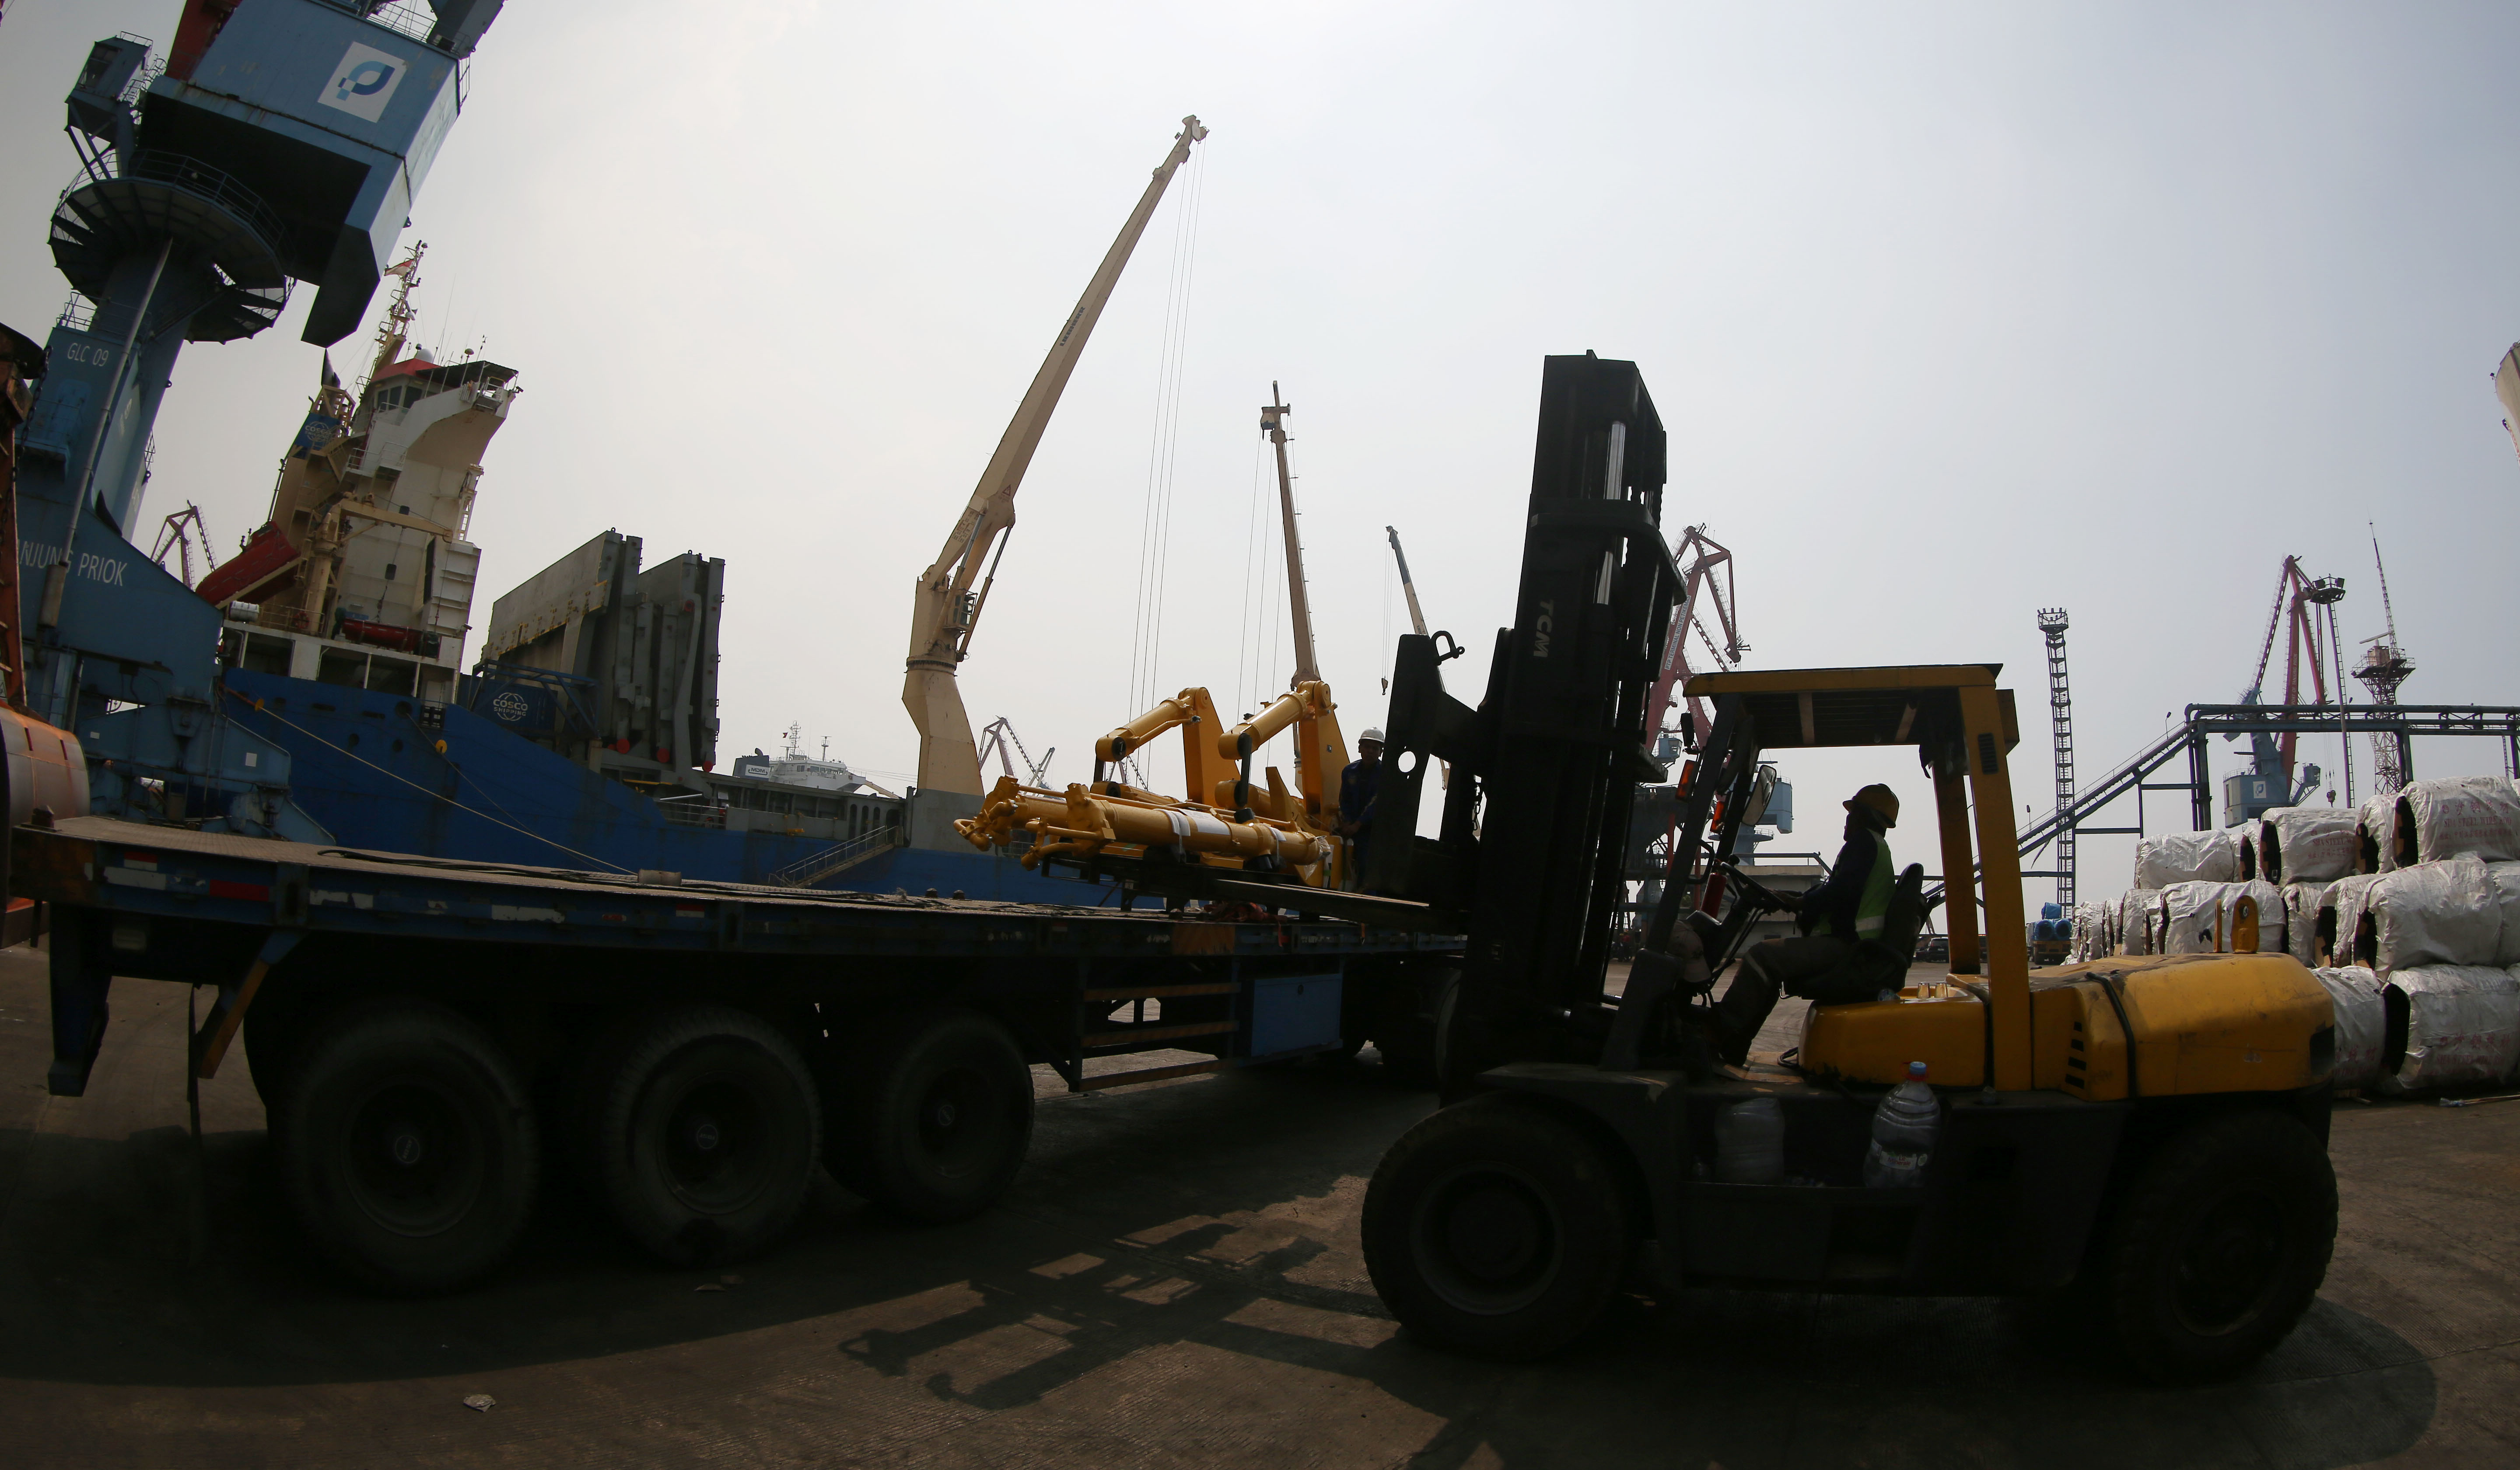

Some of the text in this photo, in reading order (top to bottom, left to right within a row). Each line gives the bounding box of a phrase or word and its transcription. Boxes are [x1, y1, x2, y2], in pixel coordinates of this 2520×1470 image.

[67, 343, 109, 367] GLC 09
[18, 539, 127, 587] NJUN PRIOK
[1533, 599, 1554, 657] TCM
[1669, 633, 1679, 659] TERMINAL
[1680, 595, 1691, 623] PETIKEMAS
[493, 699, 528, 711] COSCO
[494, 707, 526, 716] SHIPPING
[2444, 818, 2456, 827] SHA
[2458, 817, 2478, 827] STEEL
[2480, 816, 2498, 825] WIRE
